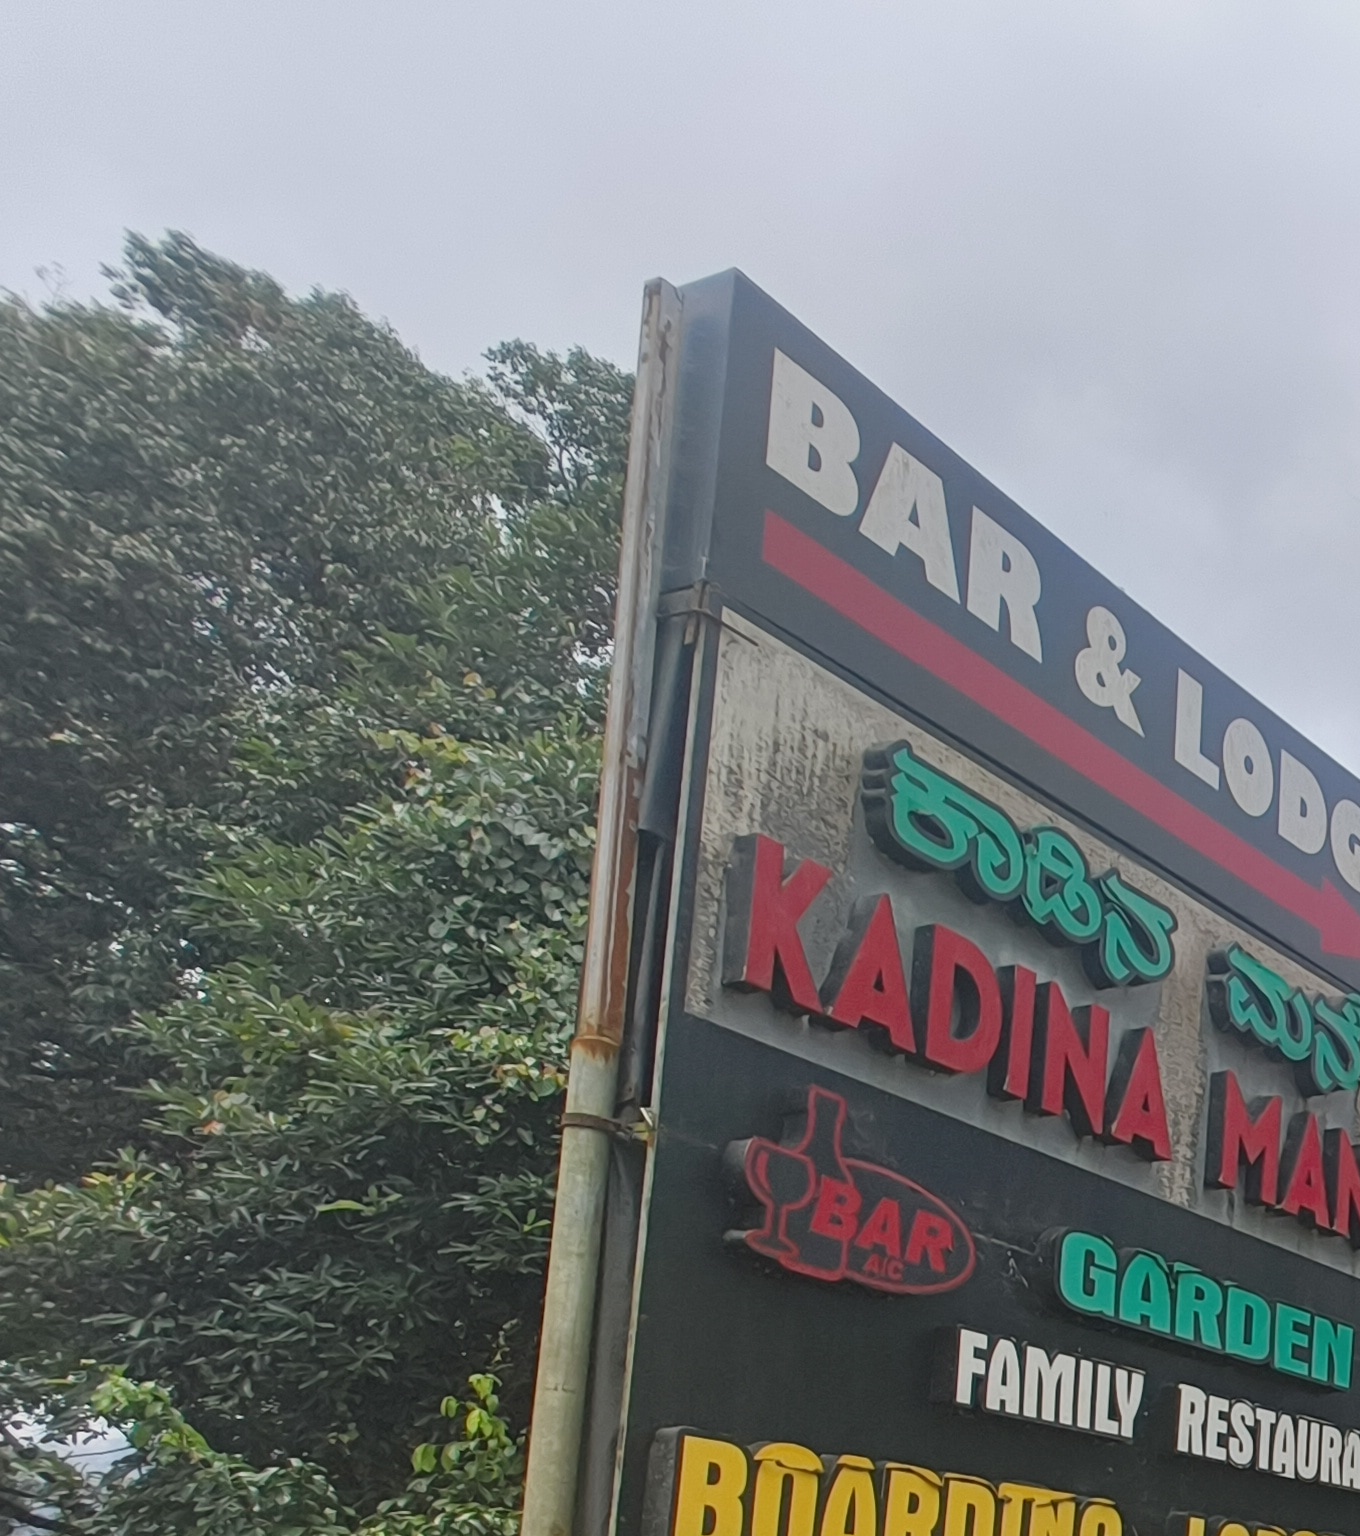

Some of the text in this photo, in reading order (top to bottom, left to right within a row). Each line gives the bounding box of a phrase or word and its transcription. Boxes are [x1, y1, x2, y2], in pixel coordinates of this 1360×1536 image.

[766, 348, 1042, 663] BAR
[1075, 605, 1145, 737] &
[892, 747, 1176, 979] ಕಾಡಿನ
[743, 833, 1172, 1161] KADINA
[810, 1174, 954, 1274] BAR
[863, 1254, 904, 1280] A/C
[956, 1327, 1145, 1439] FAMILY
[1060, 1231, 1354, 1389] GARDEN
